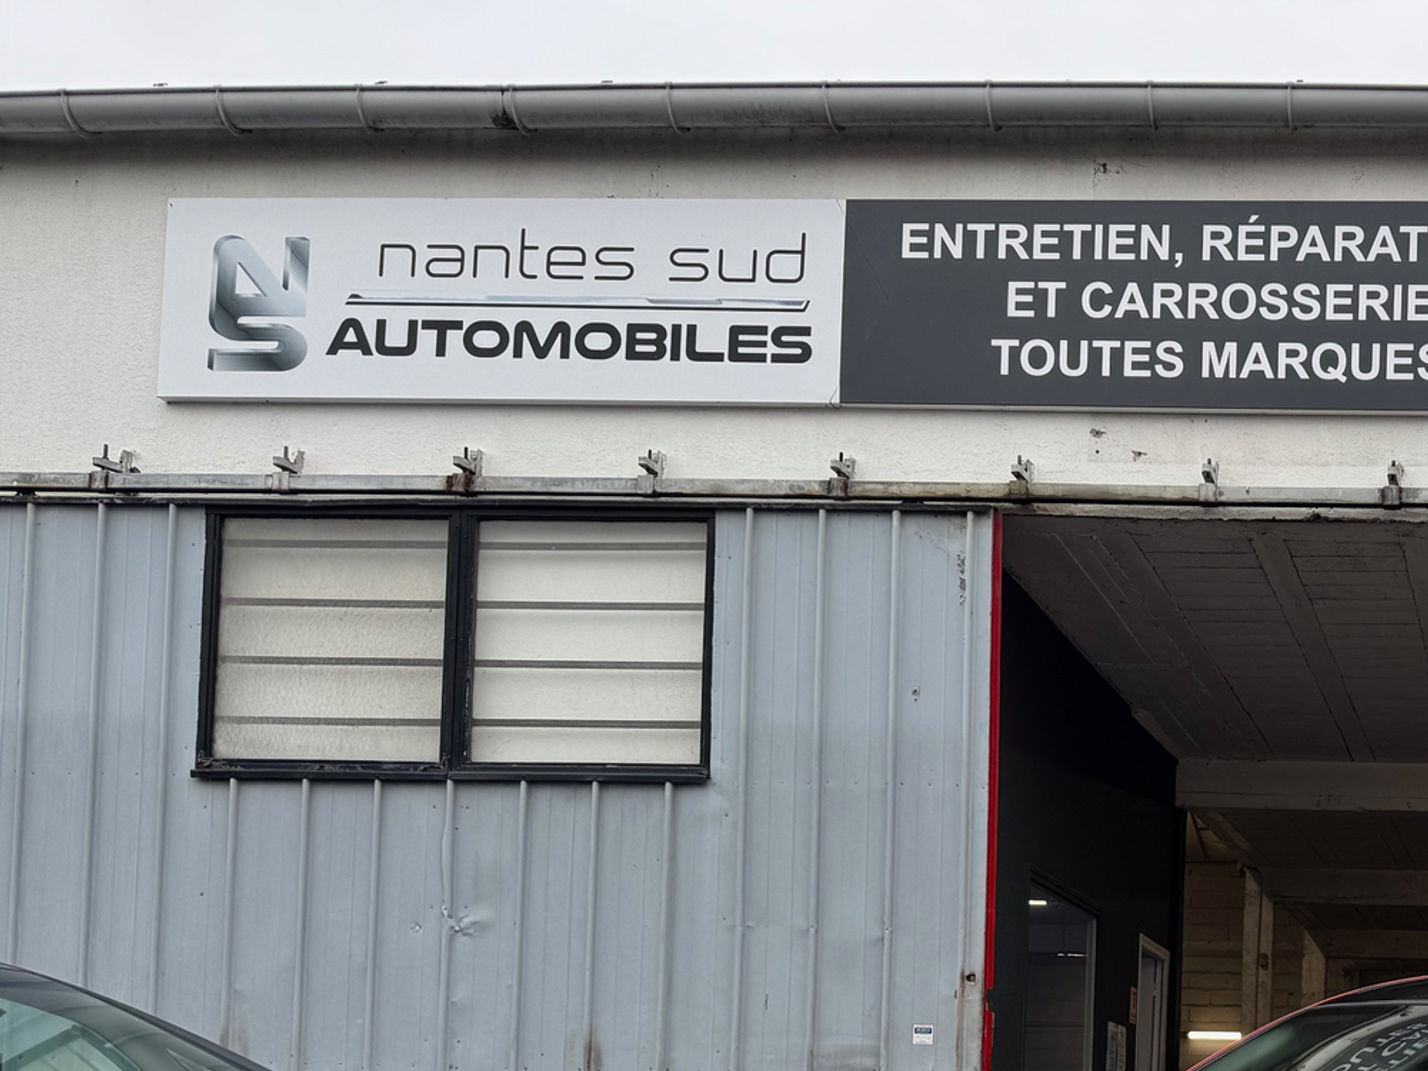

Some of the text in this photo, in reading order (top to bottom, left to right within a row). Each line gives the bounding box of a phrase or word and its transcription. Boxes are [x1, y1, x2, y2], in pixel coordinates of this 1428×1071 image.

[379, 228, 806, 284] nantes sud
[901, 222, 1183, 268] ENTRETIEN,
[1006, 281, 1067, 318] ET
[325, 317, 812, 364] AUTOMOBILES
[990, 338, 1184, 378] TOUTES
